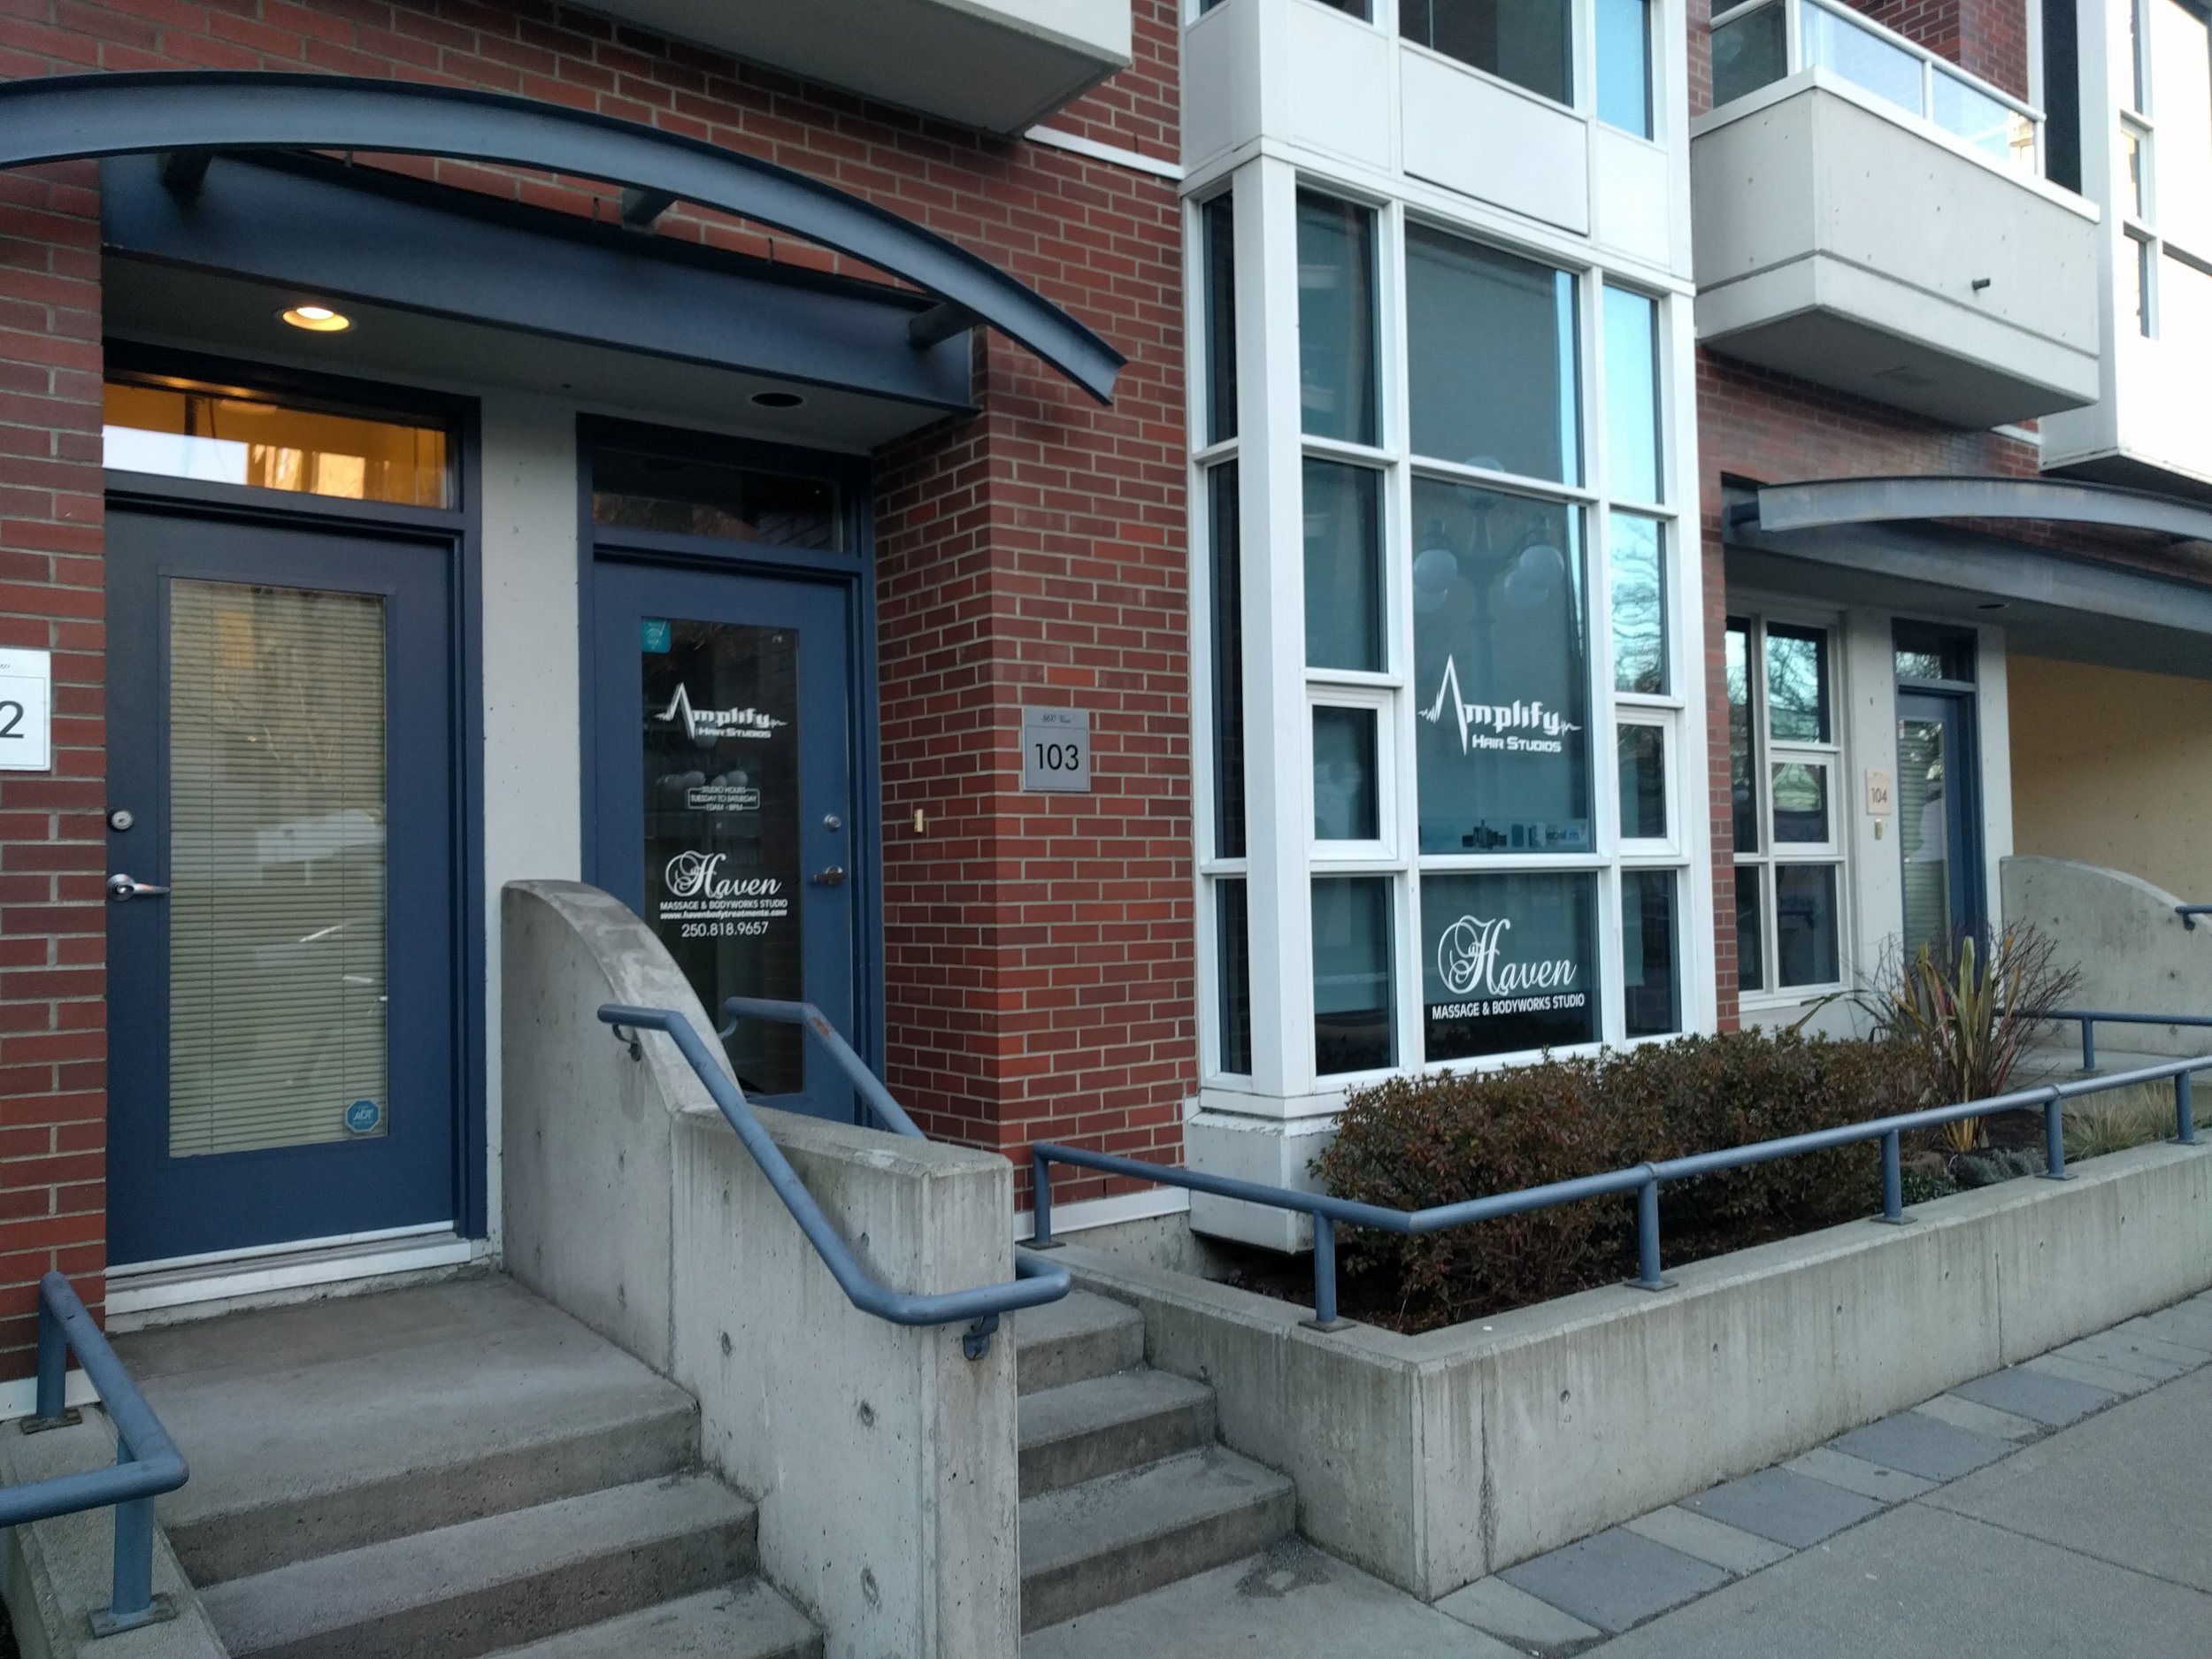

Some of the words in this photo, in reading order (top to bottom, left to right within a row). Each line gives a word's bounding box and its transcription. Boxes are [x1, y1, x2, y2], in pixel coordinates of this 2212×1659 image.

[0, 700, 25, 739] 2
[657, 682, 784, 740] Amplify
[1424, 653, 1573, 757] Amplify
[1035, 742, 1079, 771] 103
[1870, 787, 1888, 803] 104
[665, 850, 782, 900] Haven
[660, 901, 699, 911] MASSAGE
[701, 901, 708, 910] &
[709, 899, 759, 910] BODYWORKS
[760, 898, 788, 908] STUDIO
[681, 921, 769, 937] 250.818.9657
[1438, 914, 1578, 996] Haven
[1432, 1002, 1480, 1020] MASSAGE
[1482, 1002, 1490, 1016] &
[1492, 995, 1549, 1015] BODYWORKS
[1552, 993, 1586, 1009] STUDIO
[353, 1109, 373, 1120] ADT
